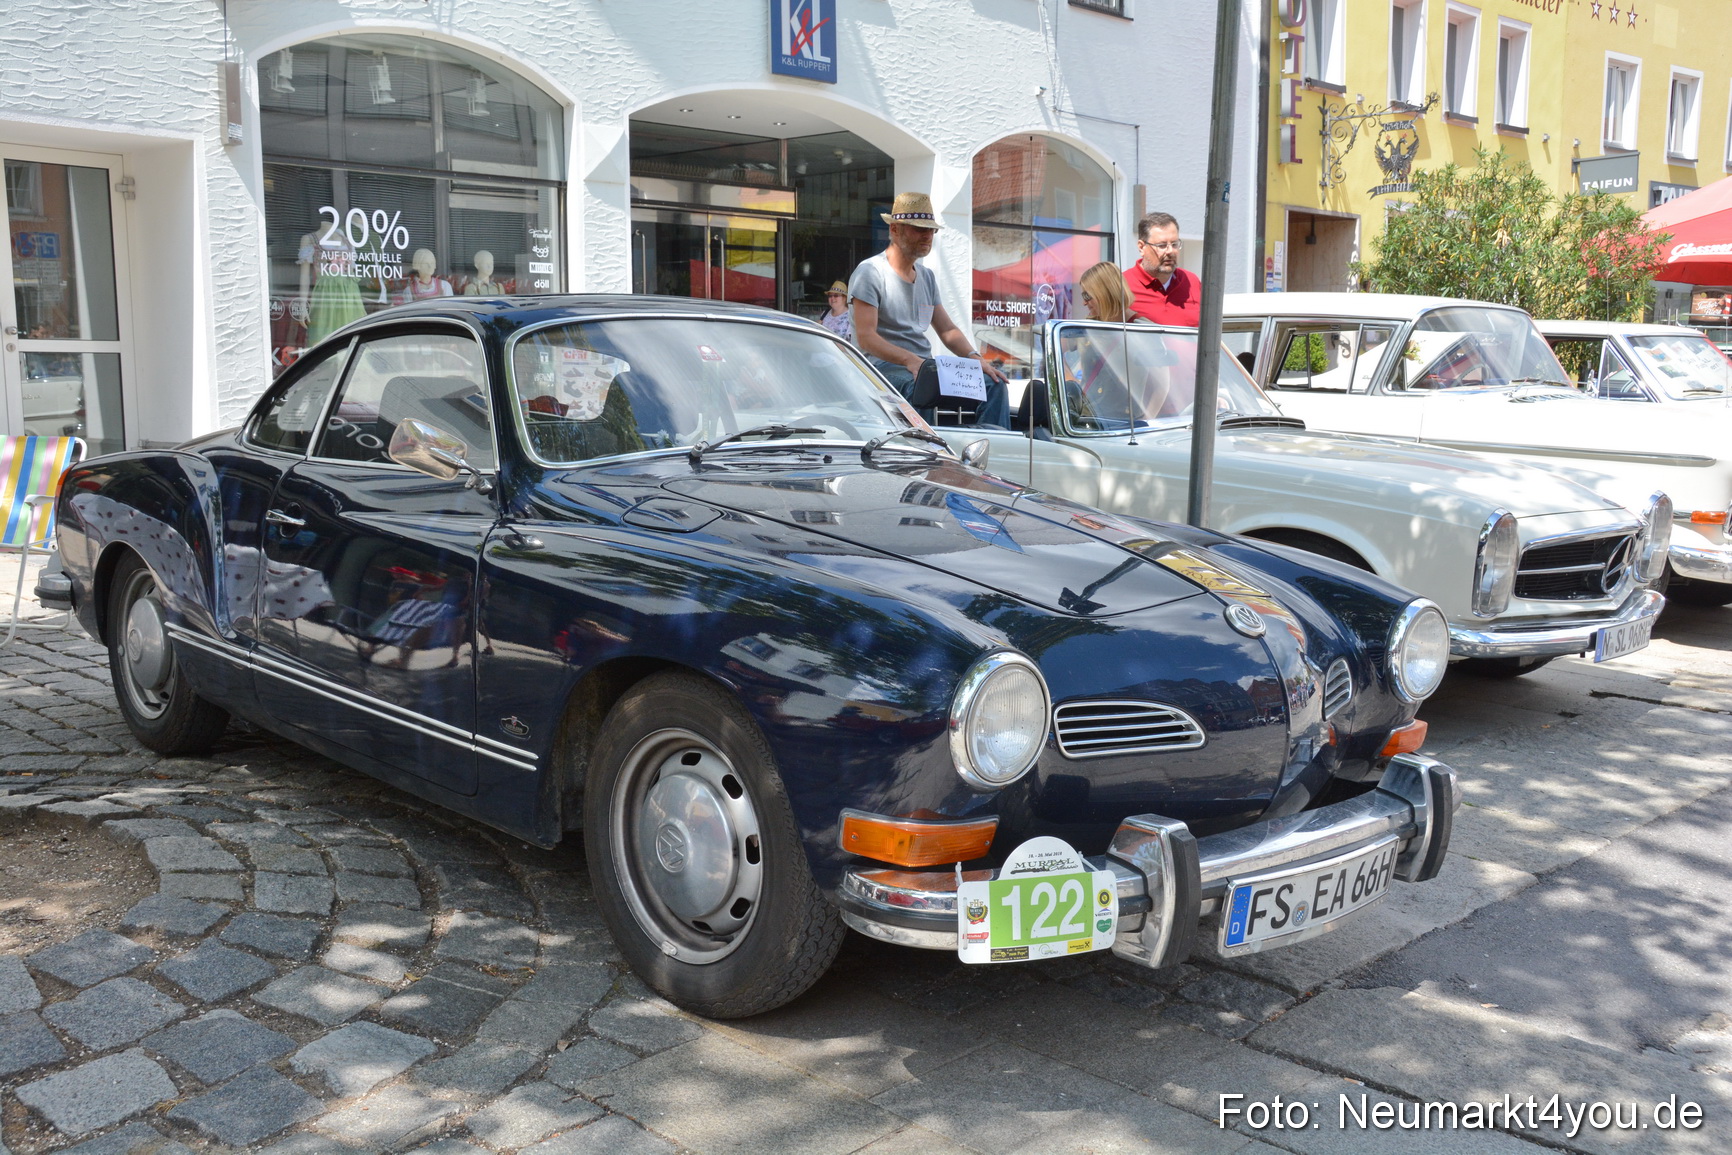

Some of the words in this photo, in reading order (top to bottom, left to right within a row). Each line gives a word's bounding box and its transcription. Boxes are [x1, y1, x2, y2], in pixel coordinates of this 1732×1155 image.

[781, 56, 797, 67] K&L
[798, 59, 831, 72] RUPPERT
[1583, 177, 1633, 190] TAIFUN
[318, 205, 410, 250] 20%
[321, 250, 340, 260] AUF
[342, 251, 357, 262] DIE
[358, 252, 402, 263] AKTUELLE
[321, 262, 402, 279] KOLLEKTION
[534, 279, 549, 289] döll
[986, 300, 1004, 312] K&L
[1006, 302, 1036, 314] SHORTS
[986, 315, 1021, 328] WOCHEN
[1615, 628, 1627, 653] SL
[1014, 857, 1075, 869] MURTAL
[1231, 921, 1240, 935] D
[1247, 883, 1294, 936] FS
[1311, 868, 1347, 920] EA
[1351, 846, 1396, 903] 66H
[1001, 878, 1085, 941] 122
